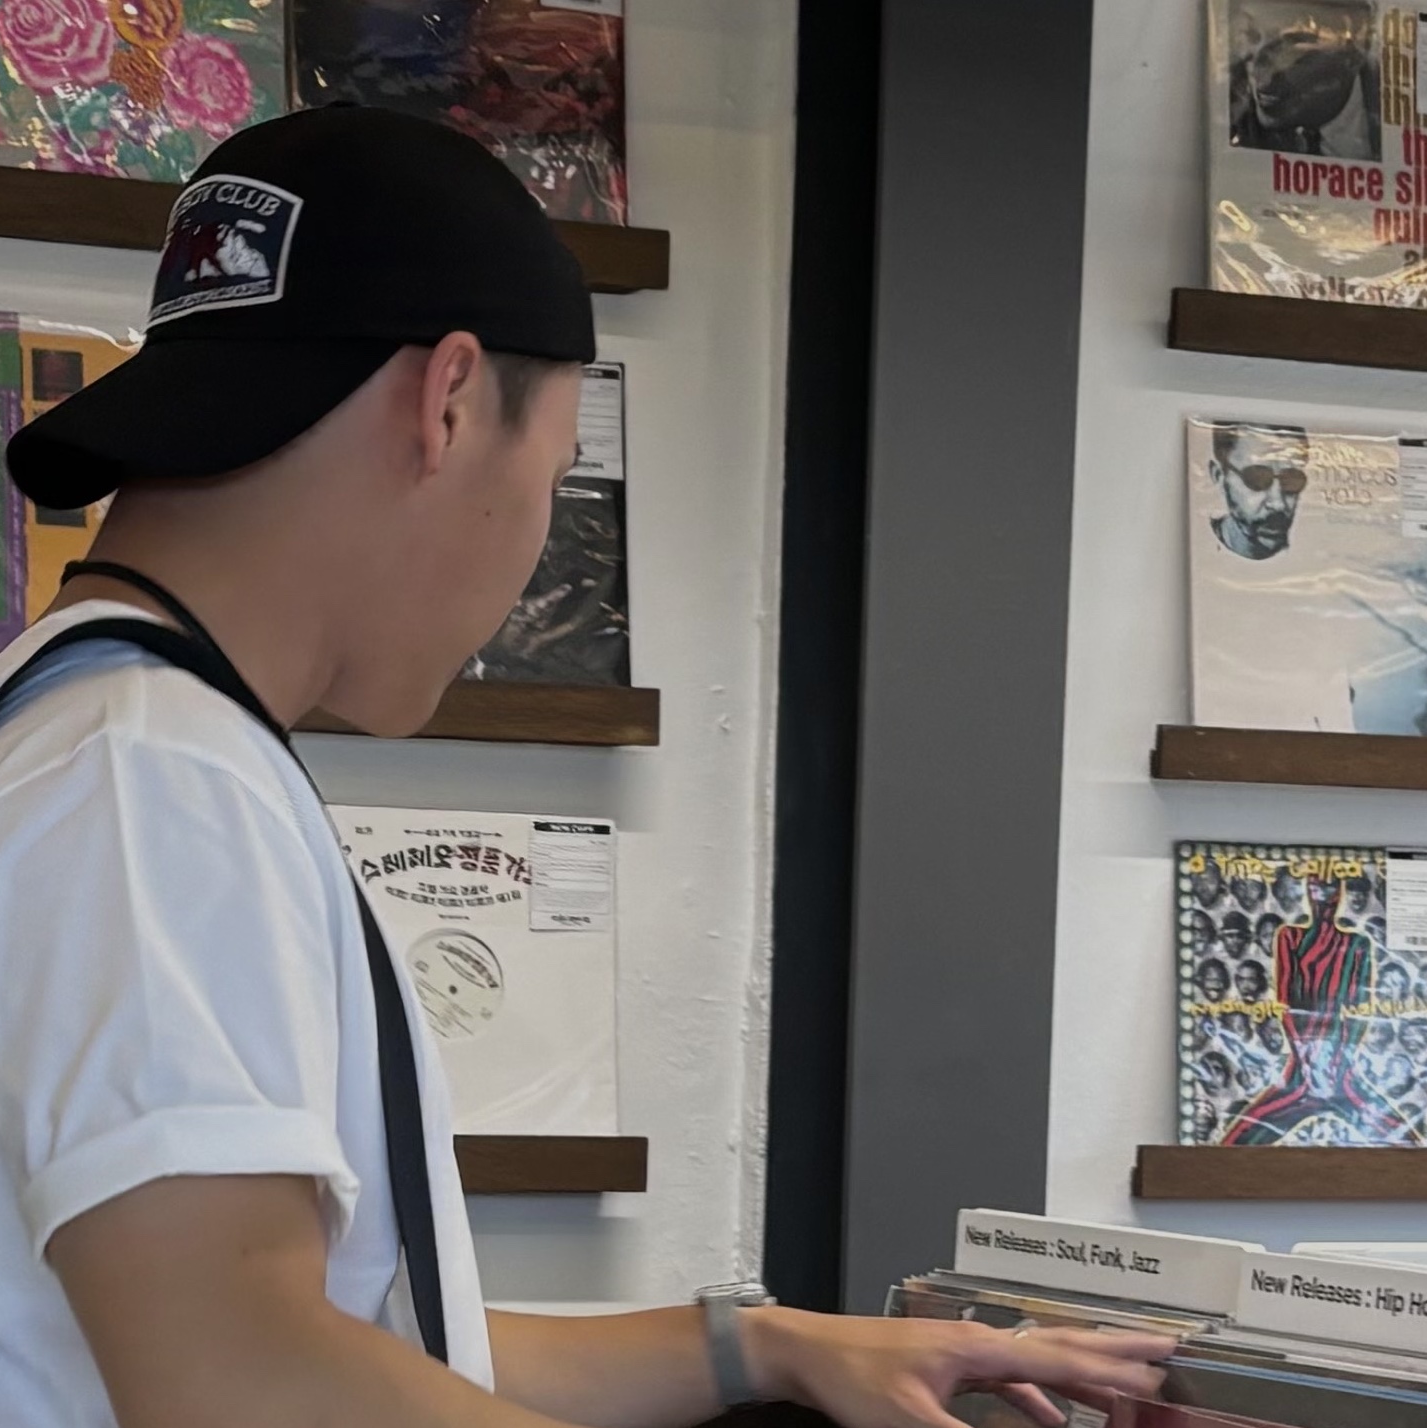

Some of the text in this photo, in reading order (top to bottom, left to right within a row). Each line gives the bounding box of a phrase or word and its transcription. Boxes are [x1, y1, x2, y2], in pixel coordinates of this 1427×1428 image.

[215, 183, 282, 217] CLUB
[1273, 153, 1385, 202] horace
[965, 1225, 991, 1247] New
[994, 1228, 1047, 1256] Releases
[1056, 1237, 1088, 1267] Soul,
[1090, 1243, 1126, 1273] Funk,
[1128, 1250, 1161, 1275] Jazz
[1251, 1268, 1287, 1296] New
[1291, 1274, 1364, 1307] Releases
[1375, 1286, 1405, 1317] Hip
